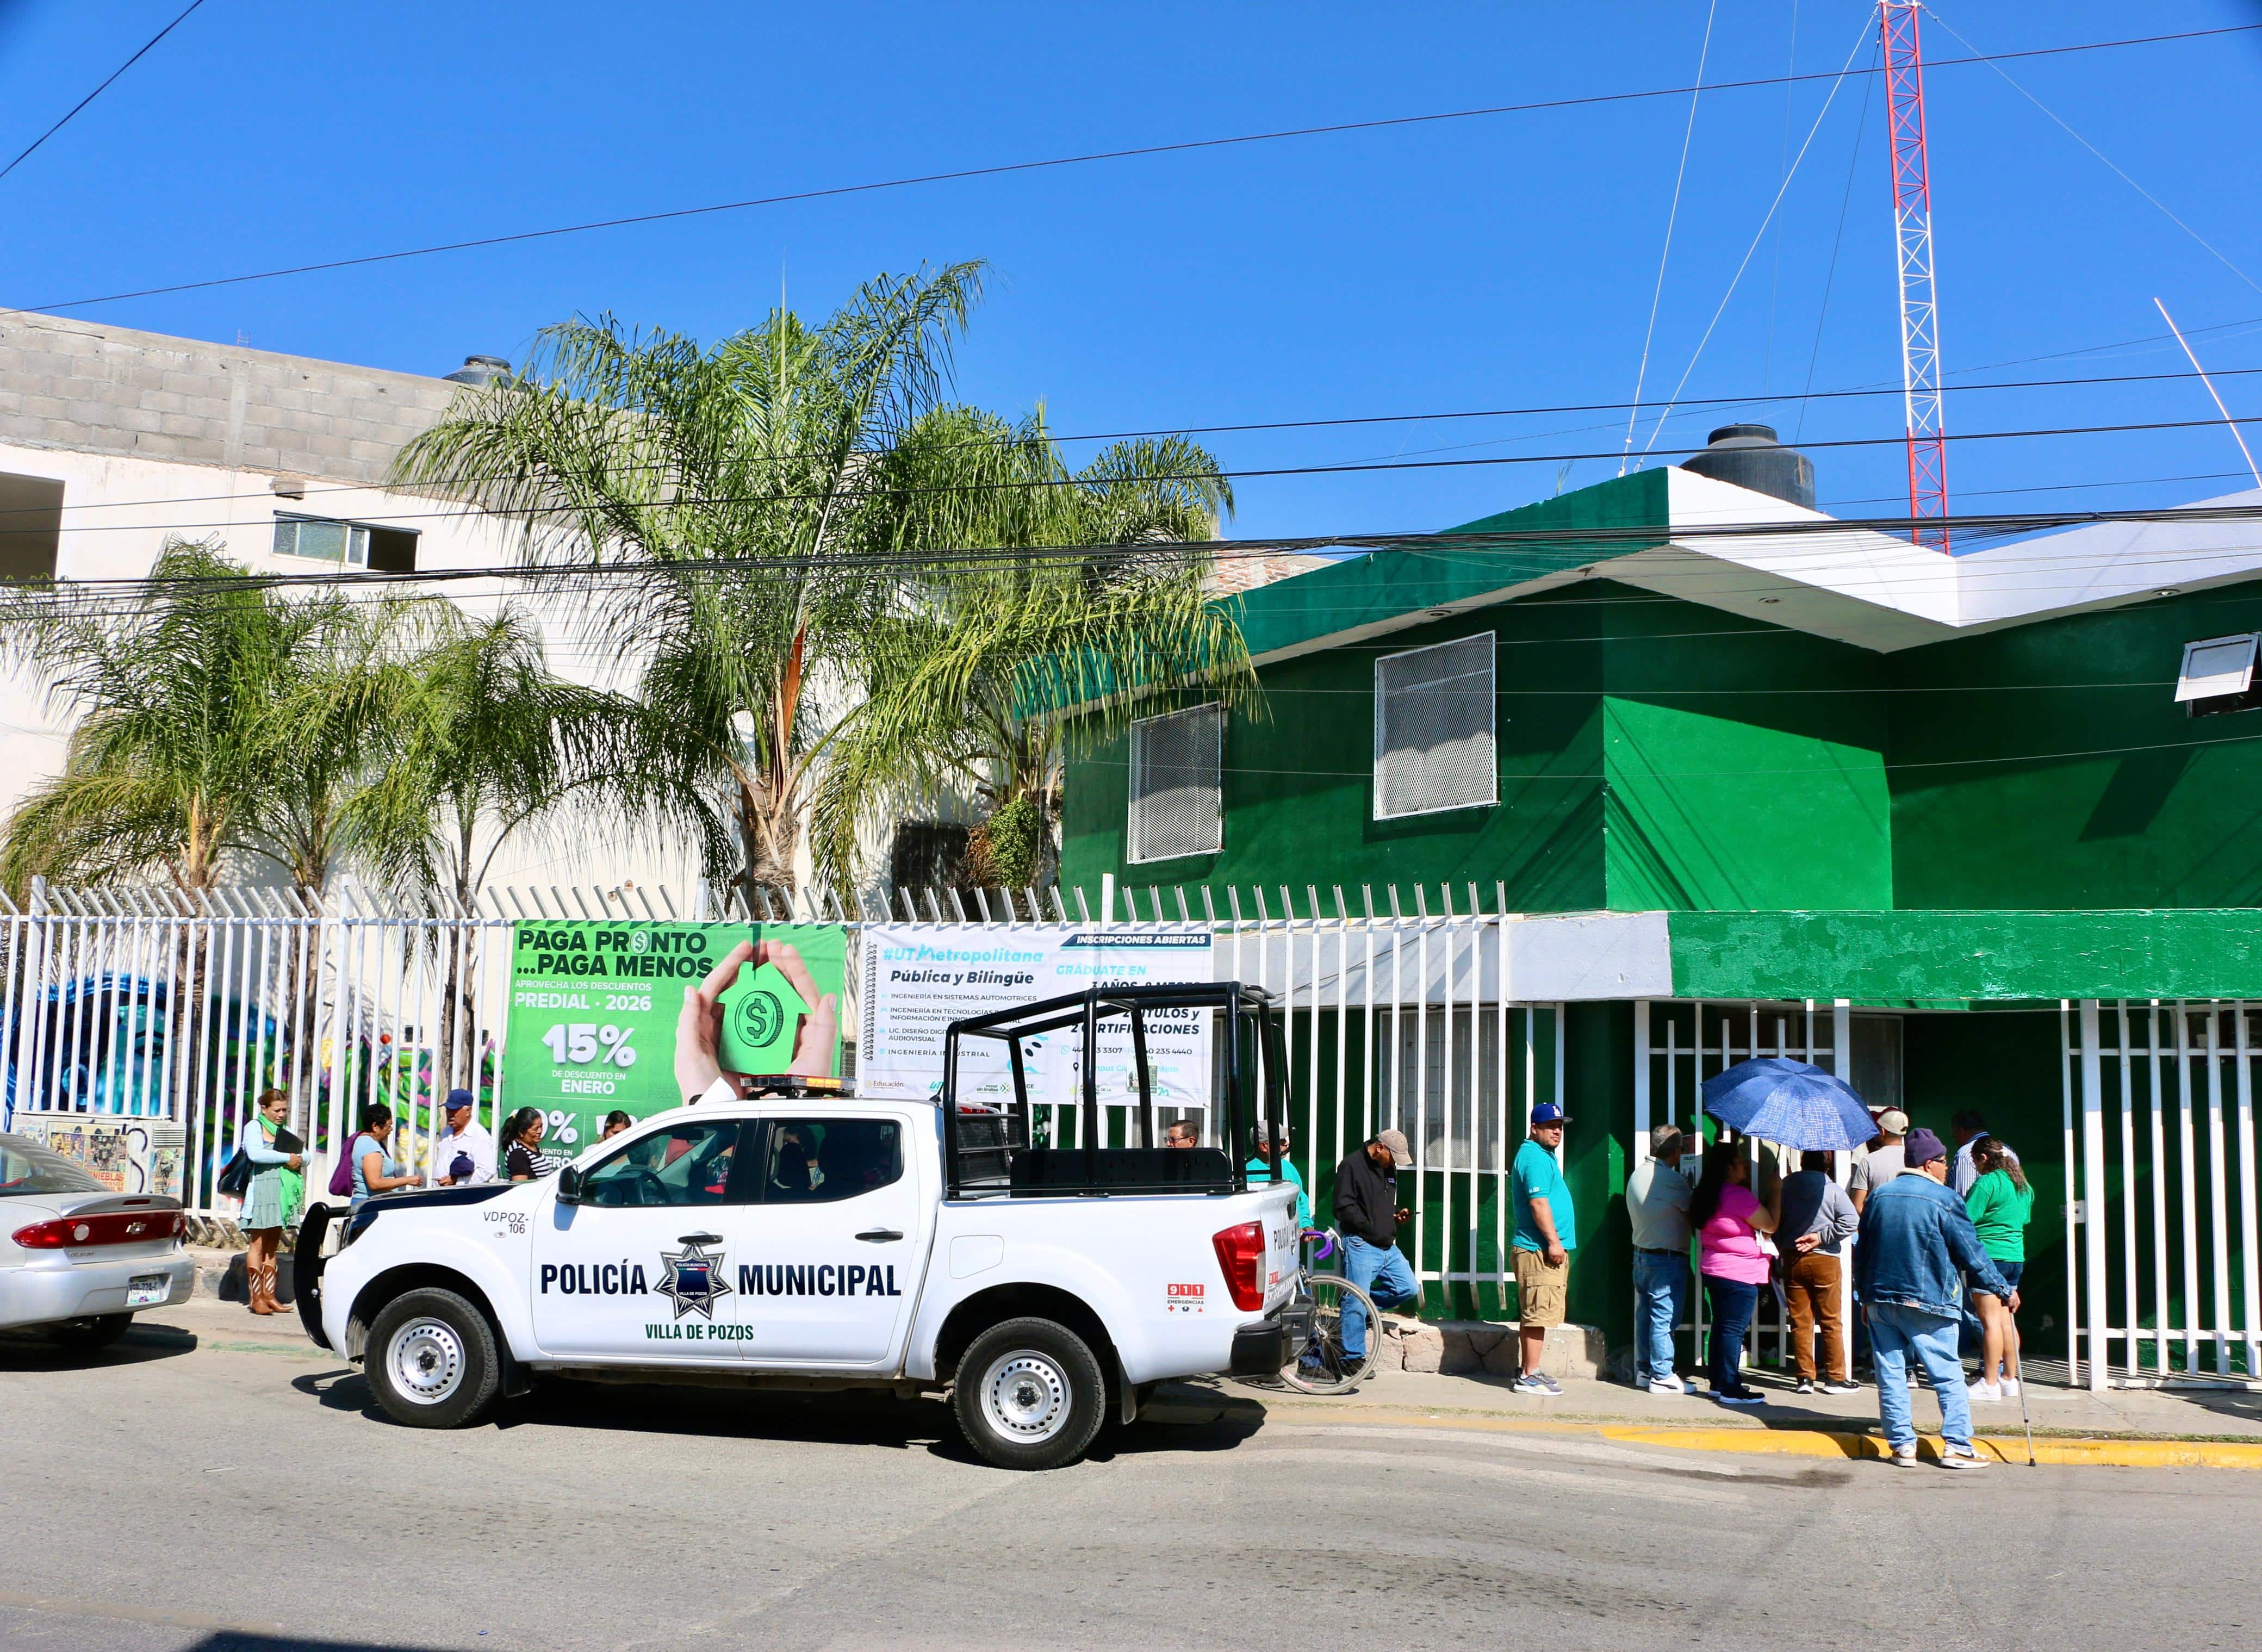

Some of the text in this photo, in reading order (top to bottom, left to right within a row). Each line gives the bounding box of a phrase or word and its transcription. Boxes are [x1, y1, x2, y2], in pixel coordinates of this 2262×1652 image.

[519, 930, 587, 951] PAGA
[1077, 936, 1205, 945] INSCRIPCIONES ABIERTAS
[615, 955, 713, 978] MENOS
[1128, 966, 1147, 976] EN
[891, 969, 1034, 986] Pública y Bilingüe
[515, 980, 569, 989] APROVECHA
[591, 982, 651, 991] DESCUENTOS
[515, 992, 590, 1009] PREDIAL
[605, 995, 651, 1011] 2026
[1142, 1008, 1189, 1018] TULOS
[1191, 1010, 1200, 1021] y
[1071, 1023, 1200, 1034] 2 RTIFIACIONES
[541, 1023, 637, 1067] 15%
[564, 1071, 613, 1079] DESCUENTO
[561, 1079, 615, 1095] ENERO
[91, 1171, 125, 1181] NIEBLAS
[483, 1211, 529, 1223] VDPOZ-
[508, 1223, 525, 1234] 106
[541, 1259, 902, 1296] POLICÍA MUNICIPAL
[1170, 1285, 1201, 1295] 911
[645, 1324, 754, 1340] VILLA DE POZOS
